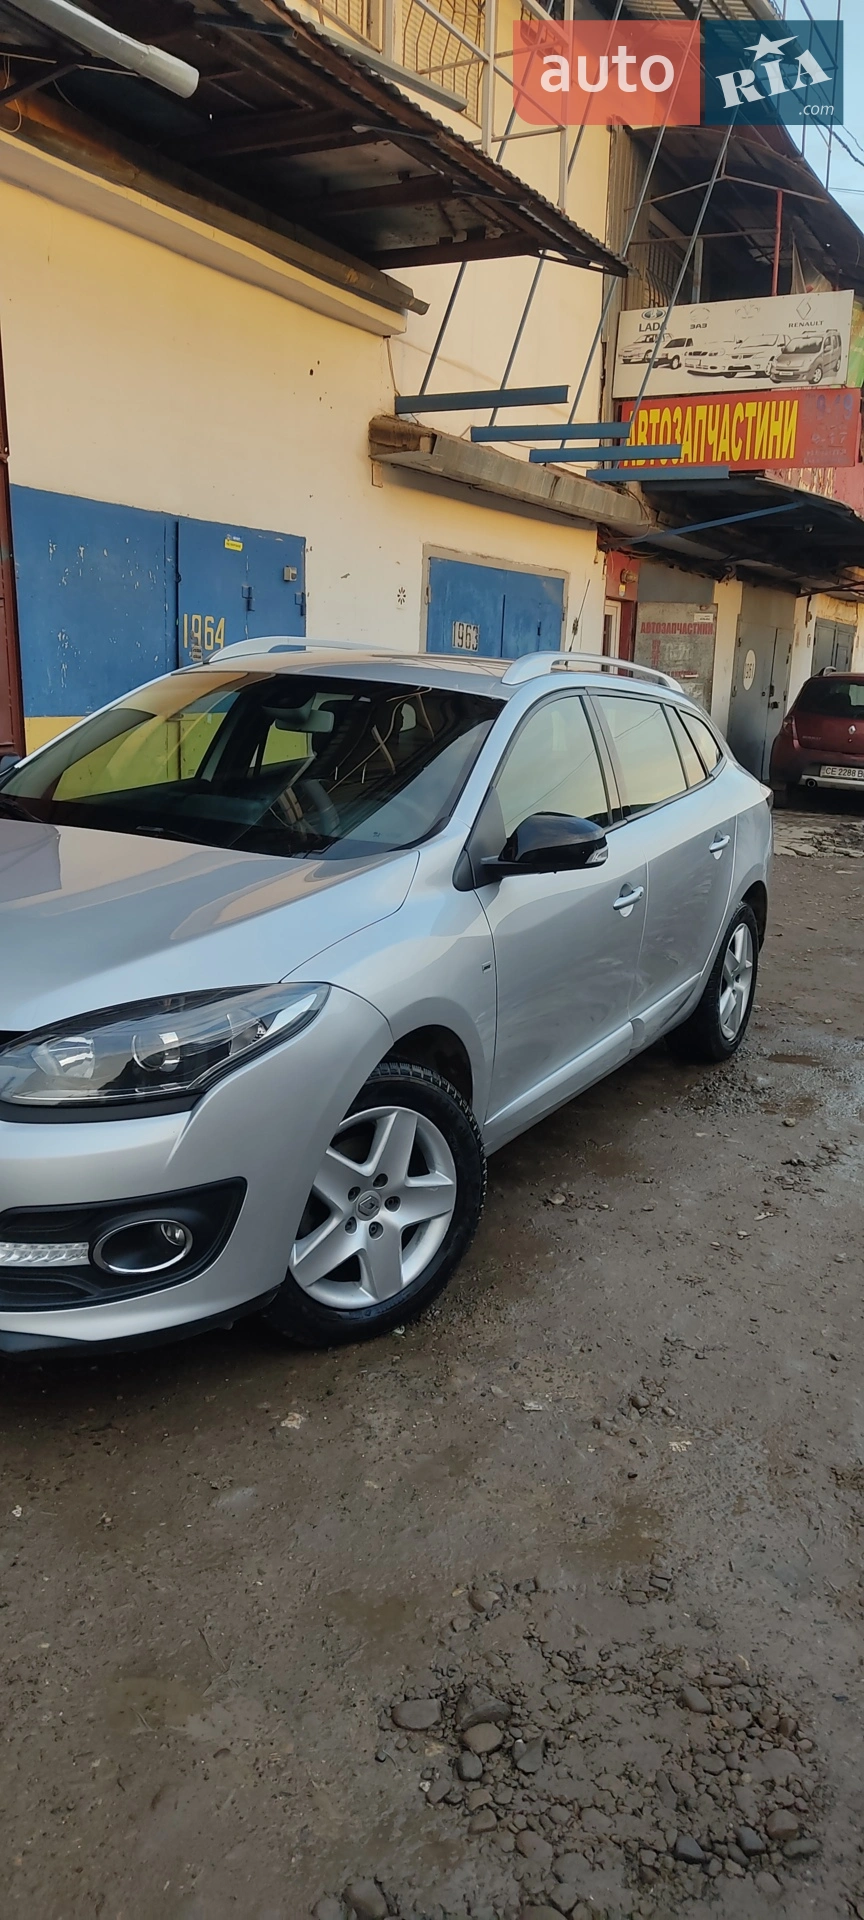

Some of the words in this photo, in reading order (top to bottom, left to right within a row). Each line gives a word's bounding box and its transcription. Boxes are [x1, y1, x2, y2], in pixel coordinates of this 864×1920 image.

[788, 320, 824, 328] RENAULT
[183, 613, 226, 651] 1964
[453, 621, 479, 651] 1963
[640, 621, 714, 636] АВТОЗАПЧАСТИНИ
[825, 766, 838, 777] CE
[838, 767, 857, 778] 2288
[857, 769, 864, 778] B
